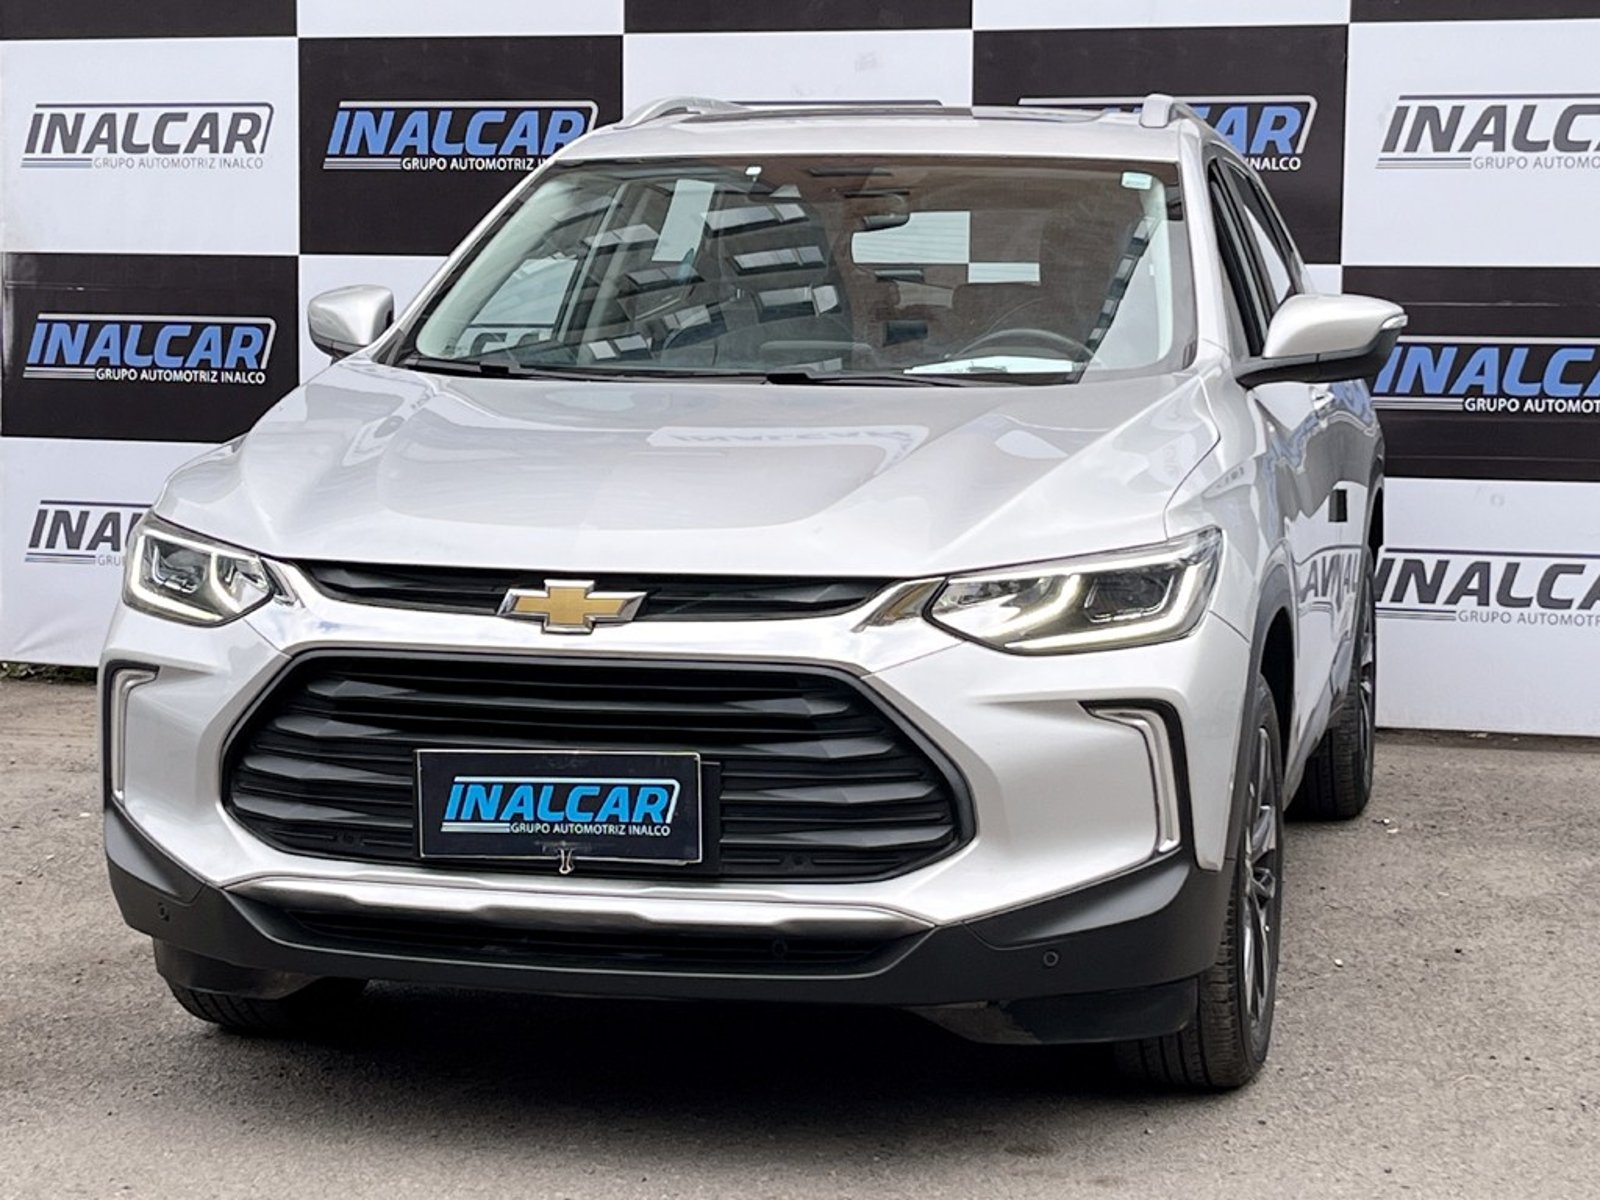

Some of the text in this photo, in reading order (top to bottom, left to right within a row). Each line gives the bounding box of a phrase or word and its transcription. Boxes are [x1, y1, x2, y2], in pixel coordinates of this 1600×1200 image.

[24, 112, 262, 154] INALCAR
[327, 110, 585, 156] INALCAR
[1381, 104, 1600, 153] INALC
[94, 157, 263, 169] GRUPO AUTOMOTRIZ INALCO
[402, 157, 447, 171] GRUPO
[450, 157, 534, 171] AUTOMOTRIZ
[1473, 156, 1527, 169] GRUPO
[26, 322, 264, 369] INALCAR
[96, 368, 266, 384] GRUPO AUTOMOTRIZ INALCO
[1464, 397, 1520, 412] GRUPO
[98, 555, 121, 566] GRU
[1458, 609, 1511, 624] GRUPO
[444, 783, 669, 823] INALCAR
[510, 822, 671, 837] GRUPO AUTOMOTRIZ INALCO
